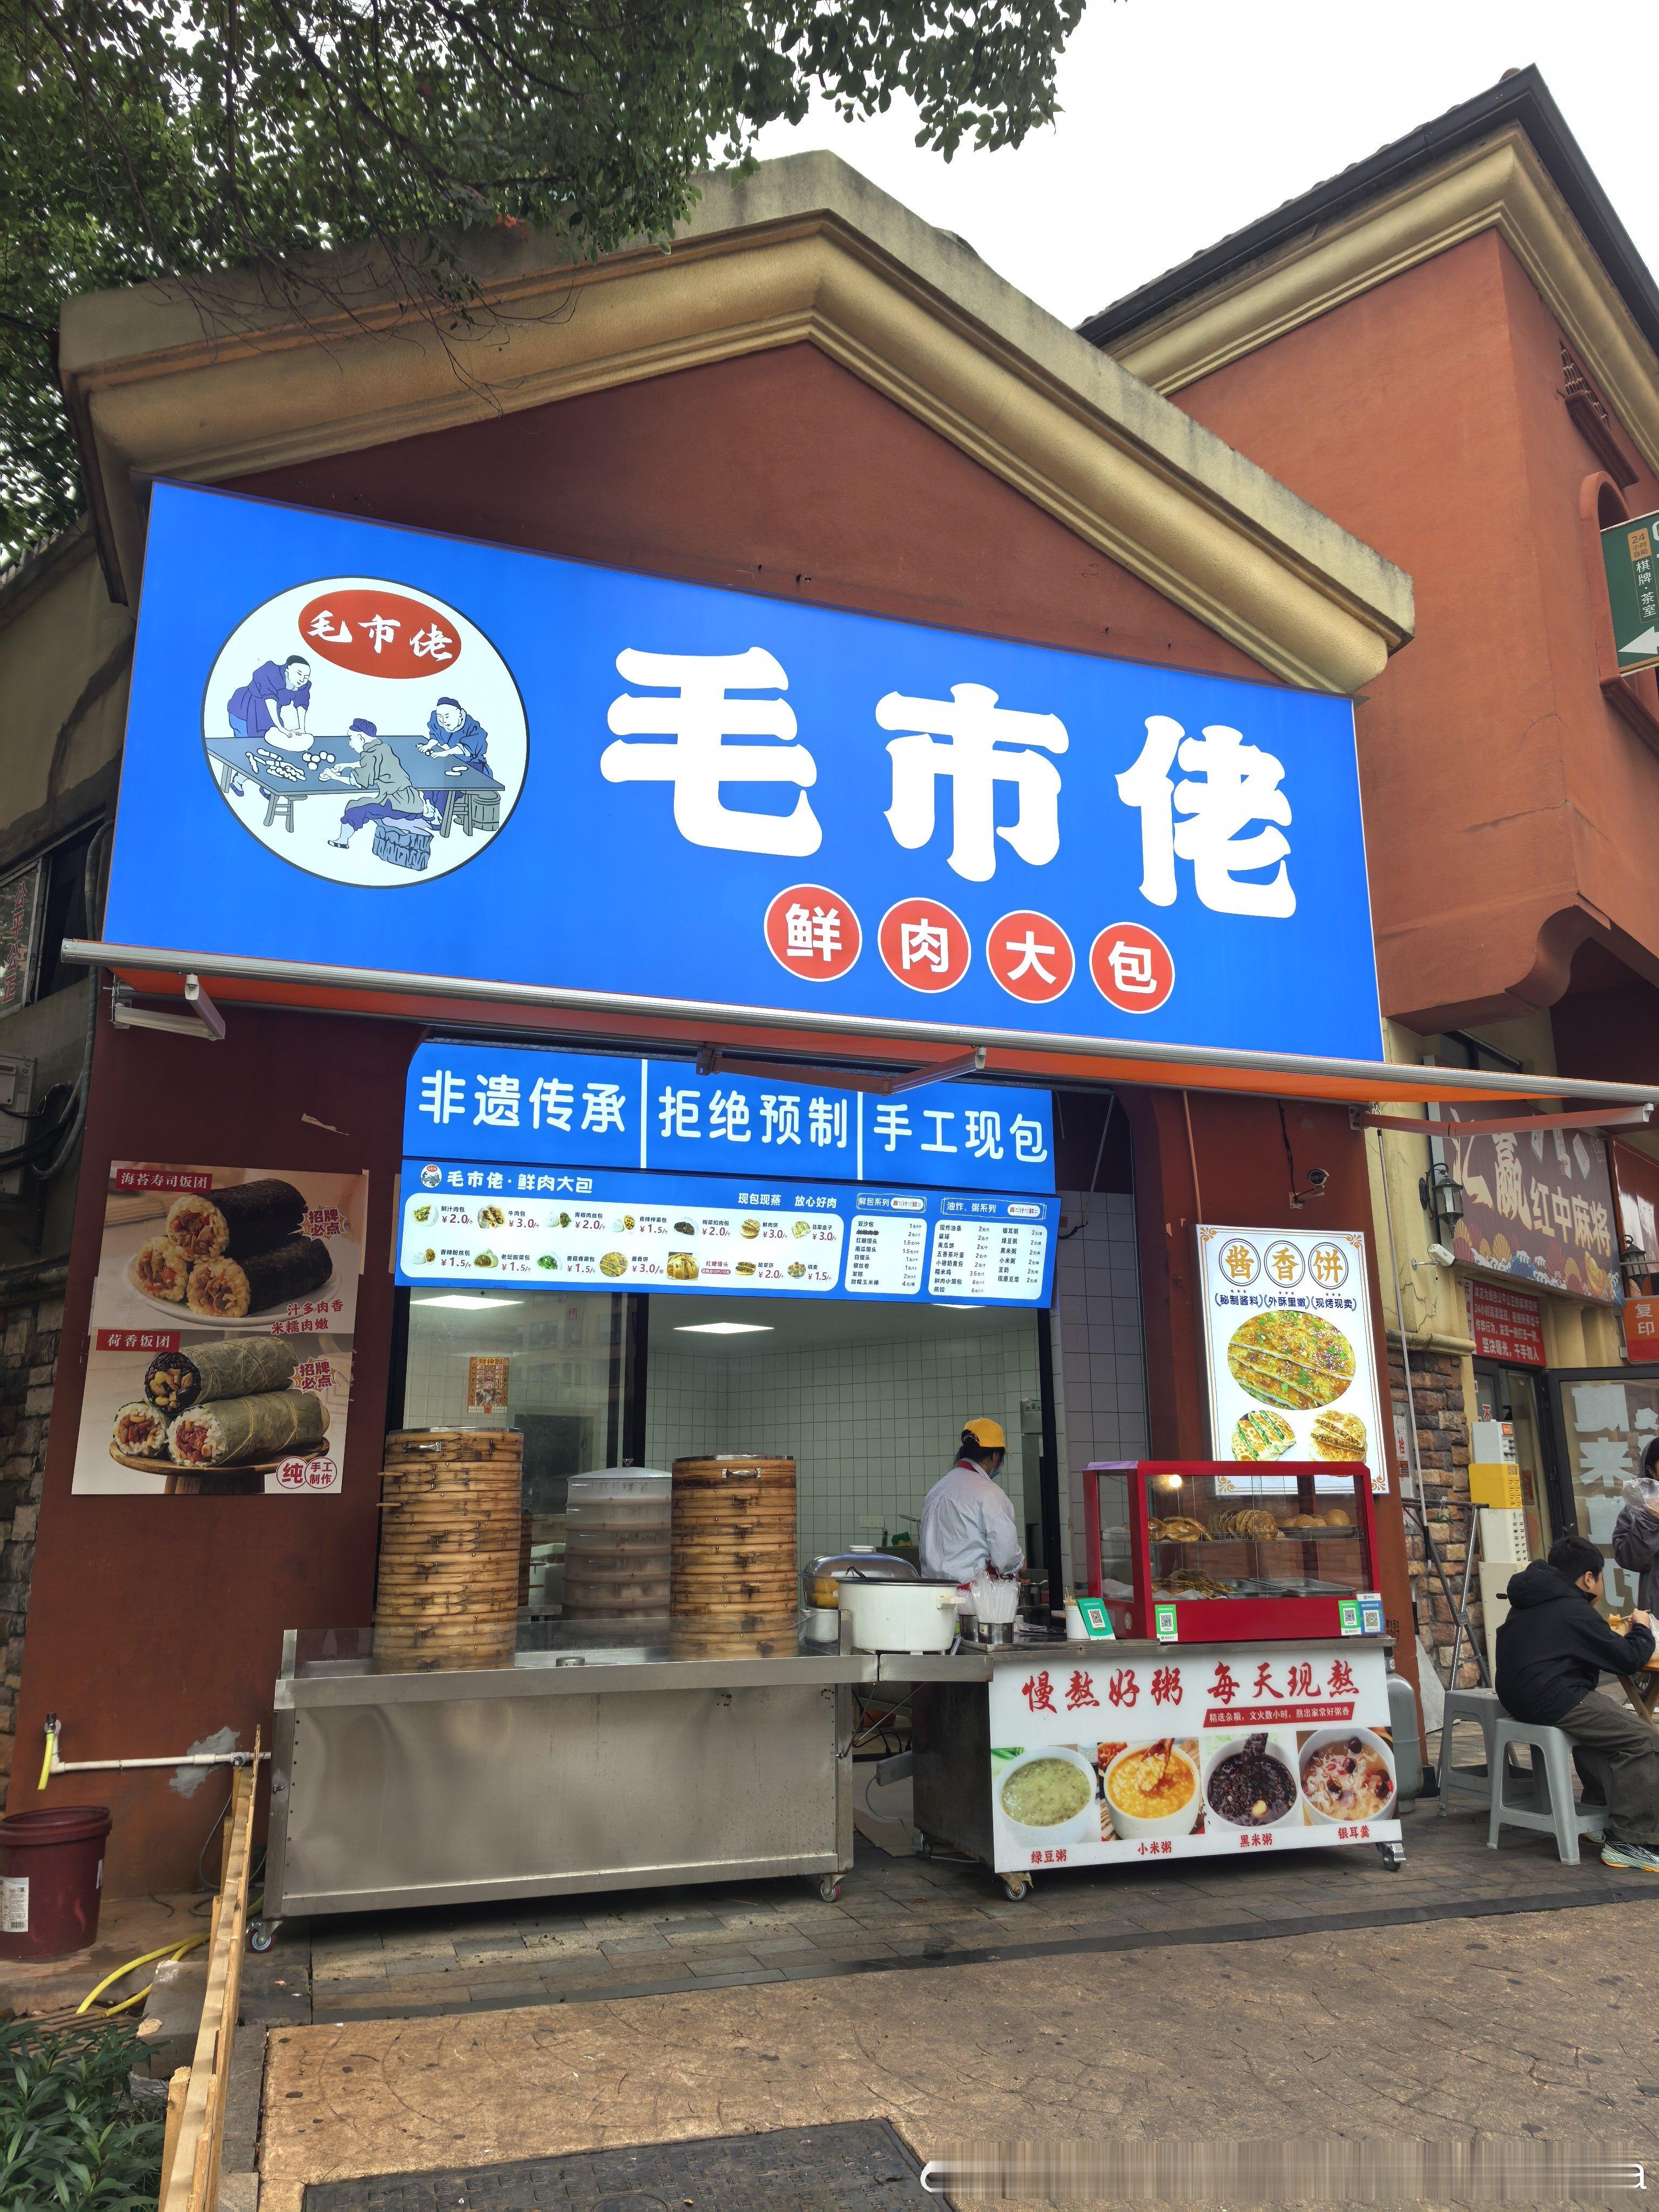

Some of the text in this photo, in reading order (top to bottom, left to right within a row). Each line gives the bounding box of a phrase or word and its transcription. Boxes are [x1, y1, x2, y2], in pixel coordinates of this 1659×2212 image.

[1631, 533, 1645, 543] 24
[1633, 541, 1647, 551] 小时
[1633, 550, 1648, 558] 自助
[1636, 558, 1657, 618] 棋牌·茶室
[307, 610, 454, 661] 毛市佬
[601, 647, 1296, 918] 毛市佬
[786, 902, 1157, 994] 鲜肉大包
[419, 1070, 625, 1132] 非遗传承
[659, 1086, 847, 1148] 拒绝预制
[874, 1104, 1047, 1162] 手工现包
[121, 1173, 207, 1189] 海苔寿司饭团
[447, 1170, 592, 1193] 毛市佬·鲜肉大包
[738, 1193, 837, 1208] 现包现蒸 放心好肉
[859, 1197, 889, 1206] 鲜包系列
[308, 1208, 339, 1224] 招牌
[1530, 1176, 1611, 1257] 红中麻将
[311, 1223, 341, 1237] 必点
[1225, 1245, 1343, 1284] 酱香饼
[287, 1300, 343, 1317] 汁多肉香
[1220, 1294, 1353, 1309] 秘制酱料 外酥里嫩 现烤现卖
[272, 1318, 329, 1335] 米糯肉嫩
[1635, 1303, 1655, 1336] 复印
[107, 1334, 170, 1348] 荷香饭团
[300, 1361, 331, 1377] 招牌
[302, 1374, 333, 1390] 必点
[282, 1463, 304, 1483] 纯
[311, 1462, 332, 1472] 手工
[309, 1474, 332, 1485] 制作
[1022, 1660, 1359, 1714] 慢熬好粥 每天现熬
[1240, 1833, 1272, 1847] 黑米粥
[1338, 1825, 1368, 1840] 银耳羹
[1138, 1841, 1171, 1854] 小米粥
[1030, 1850, 1066, 1864] 绿豆粥
